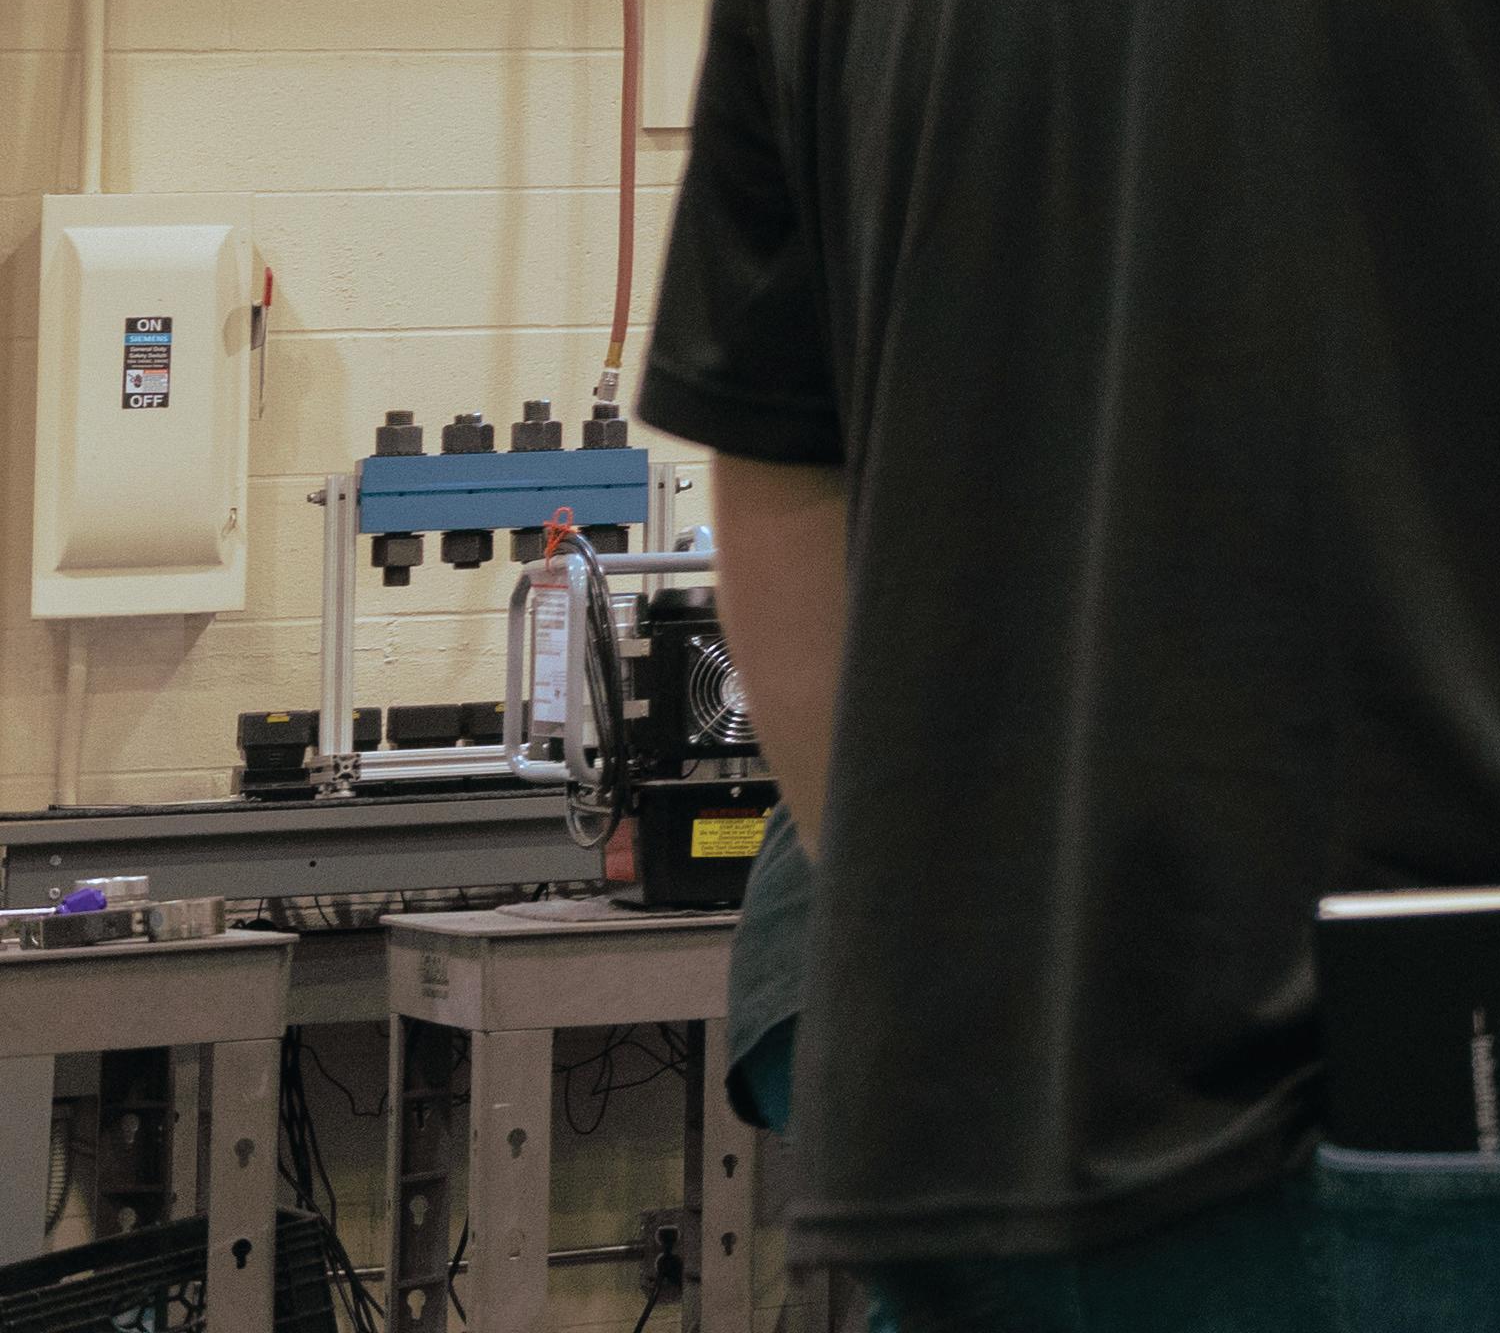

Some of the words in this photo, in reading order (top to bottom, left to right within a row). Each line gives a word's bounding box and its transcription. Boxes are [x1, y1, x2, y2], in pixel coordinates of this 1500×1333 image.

[136, 318, 163, 332] ON
[129, 334, 170, 344] SIEMENS
[129, 394, 164, 409] OFF
